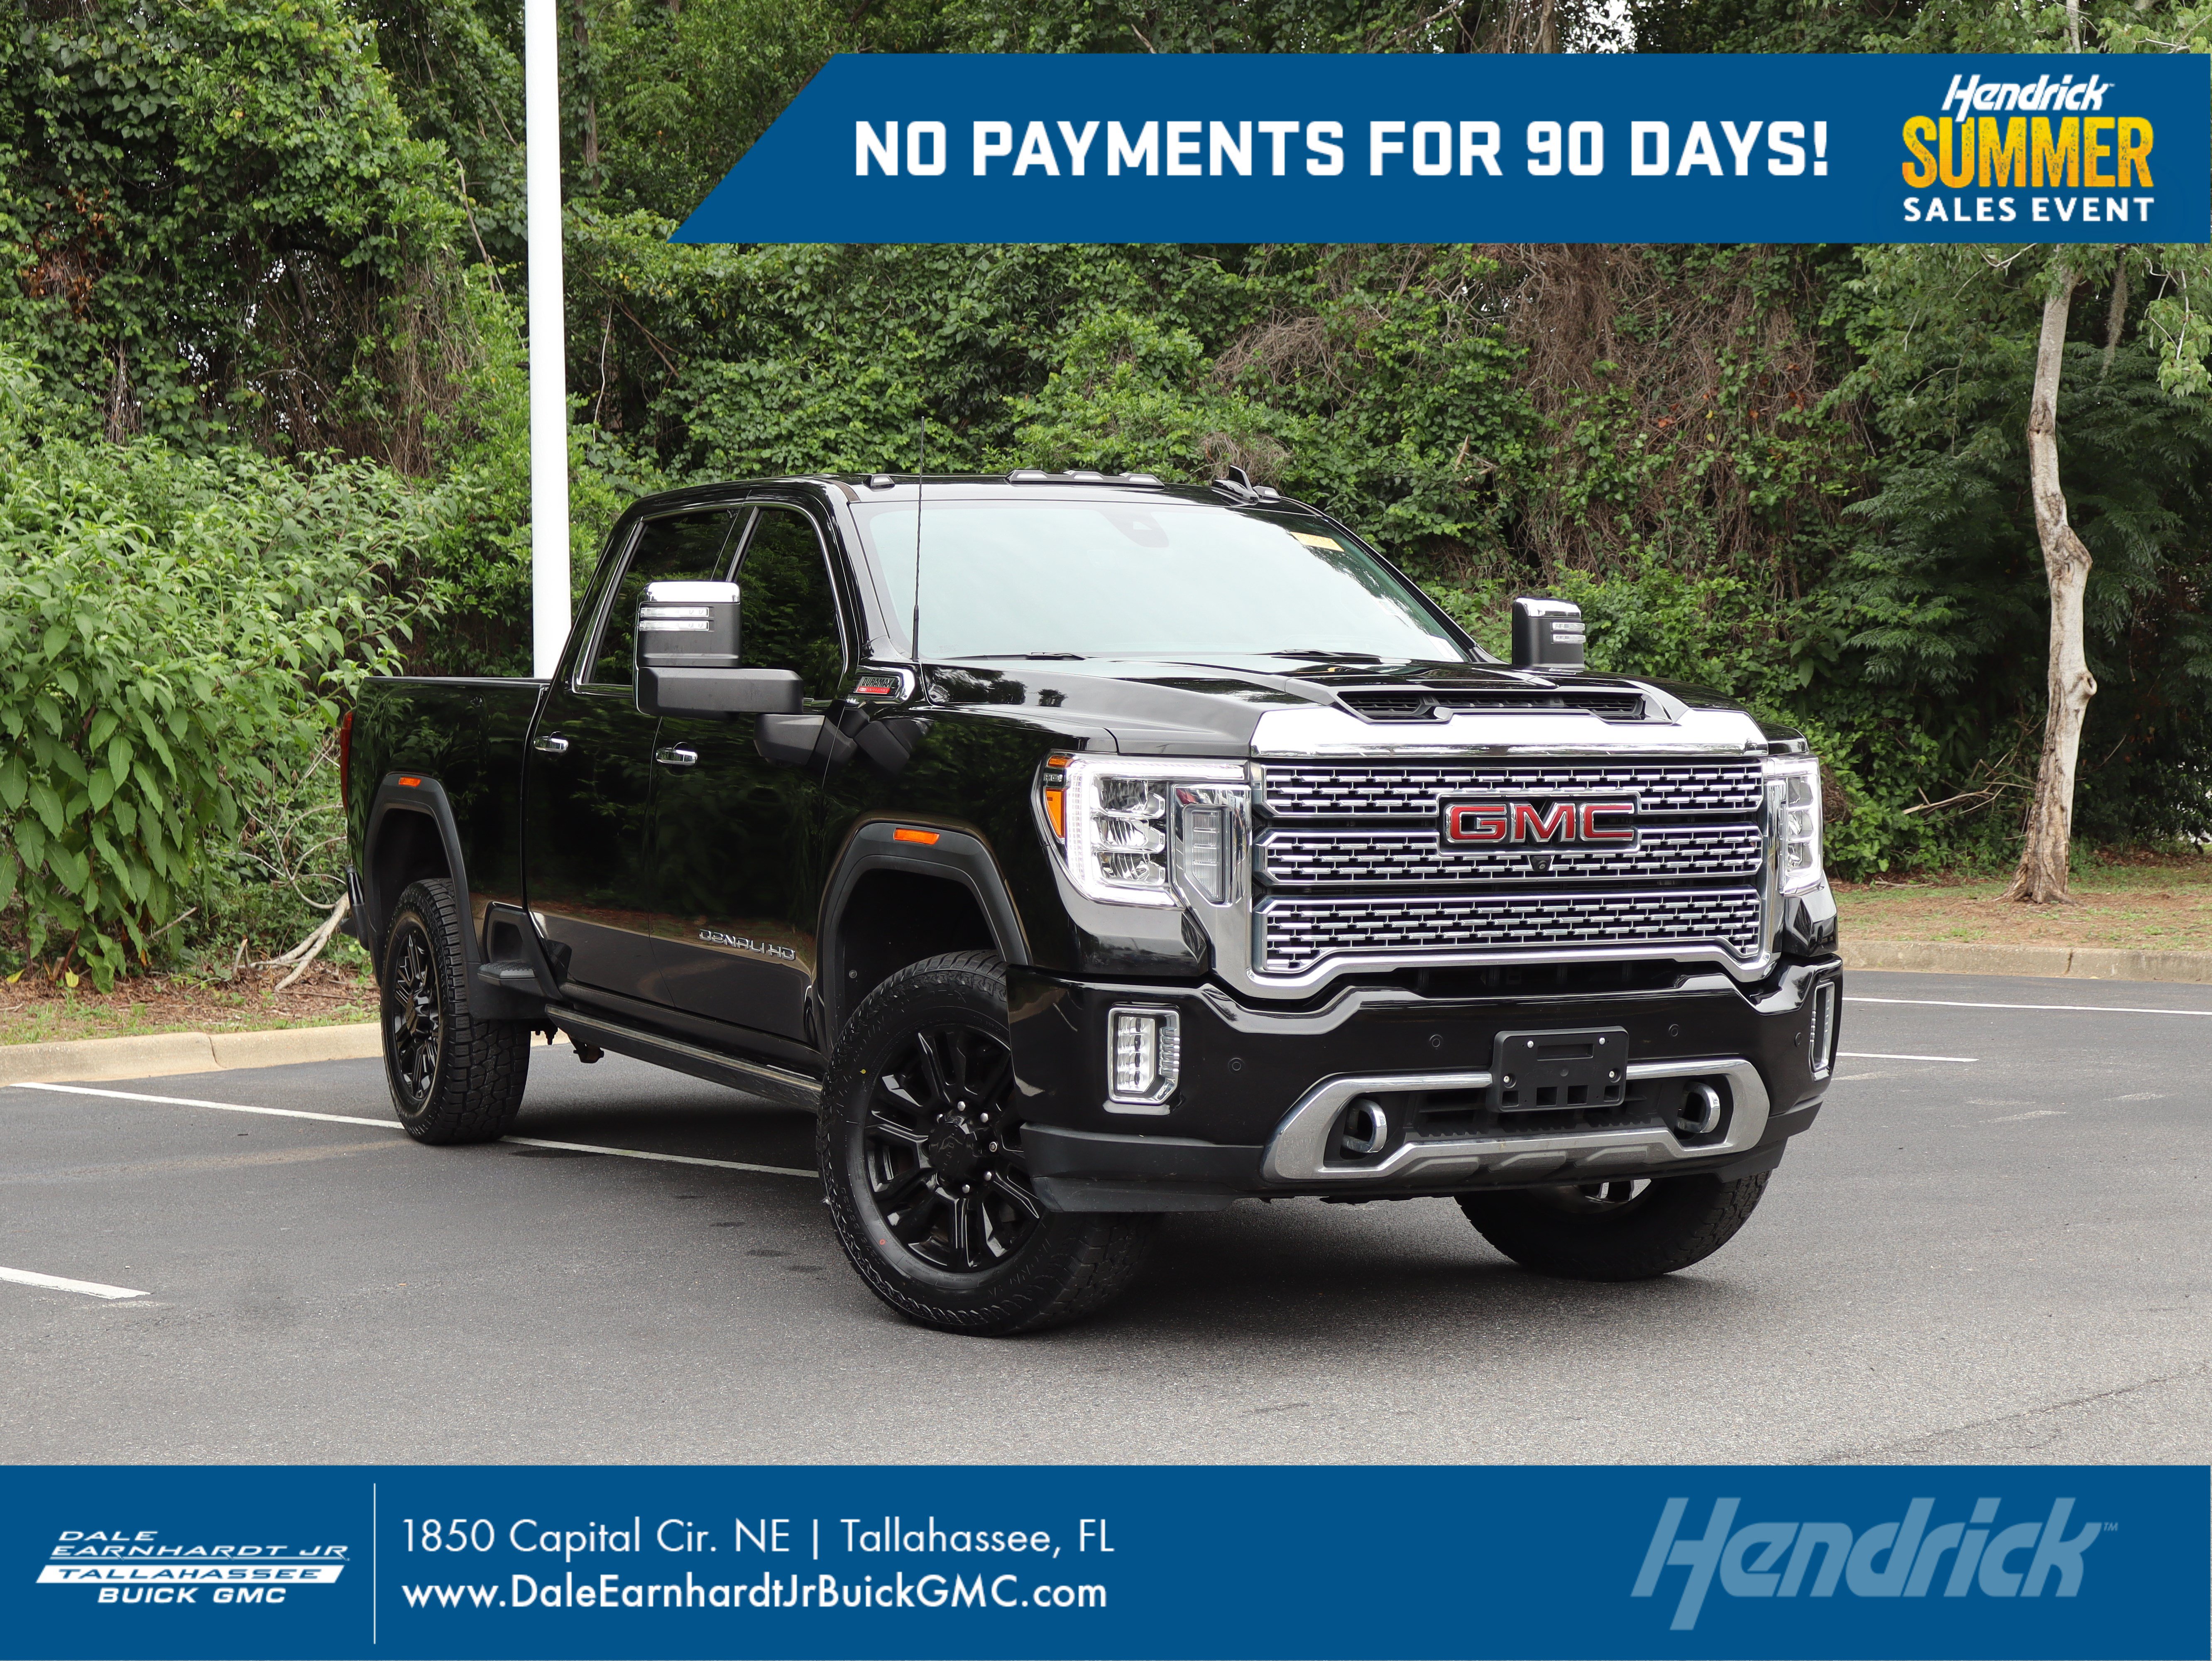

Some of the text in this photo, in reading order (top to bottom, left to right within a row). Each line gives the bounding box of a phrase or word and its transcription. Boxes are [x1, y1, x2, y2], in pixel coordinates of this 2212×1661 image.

[861, 677, 893, 688] DURAMAX
[1445, 801, 1635, 843] GMC
[699, 929, 796, 960] DENALI HD
